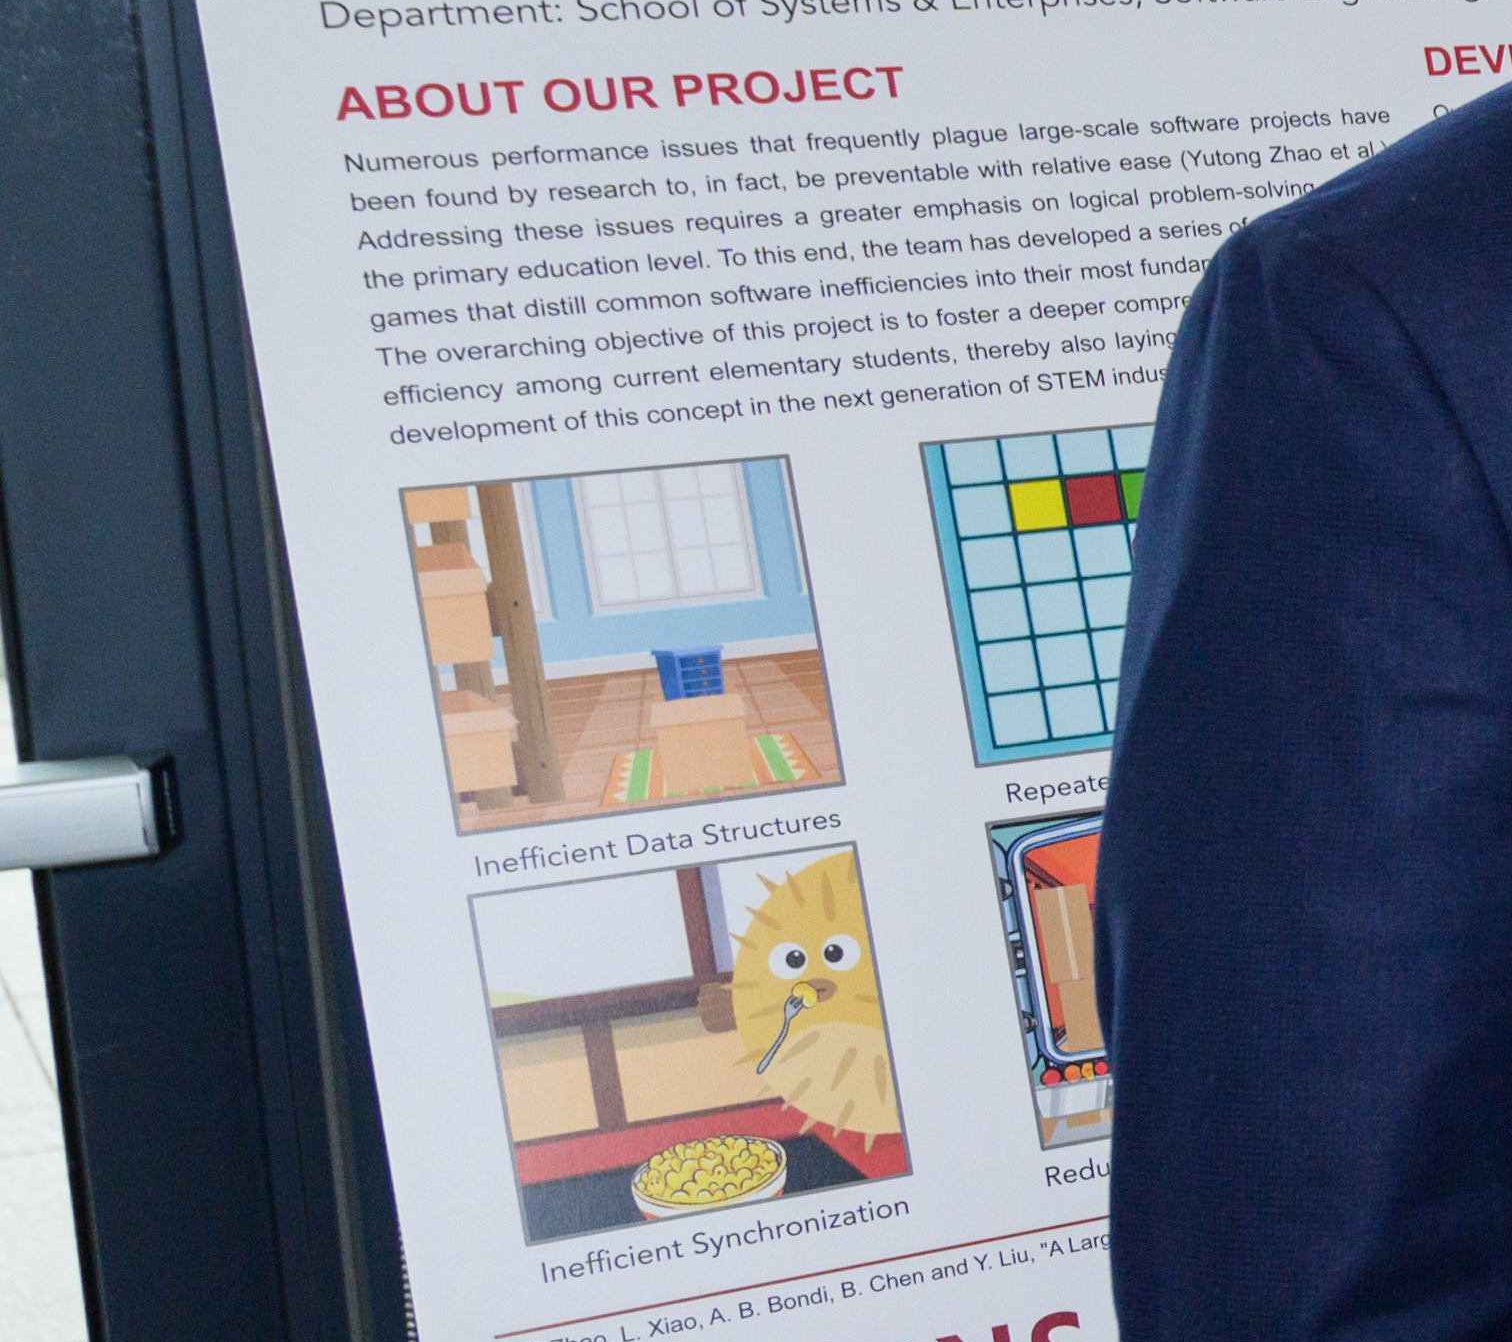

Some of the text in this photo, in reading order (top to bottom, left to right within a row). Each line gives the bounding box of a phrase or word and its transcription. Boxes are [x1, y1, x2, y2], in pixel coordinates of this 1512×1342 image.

[319, 0, 563, 37] Department:
[336, 66, 904, 121] ABOUT OUR PROJECT
[343, 108, 1390, 173] Numerous performance issues that frequently plague large-scale software projects have
[357, 225, 503, 251] Addressing
[513, 222, 584, 242] these
[595, 218, 675, 237] issues
[685, 210, 784, 235] requires
[794, 211, 809, 226] a
[819, 203, 902, 229] greater
[913, 195, 1022, 221] emphasis
[1031, 196, 1060, 212] on
[1069, 188, 1139, 213] logical
[370, 308, 458, 333] games
[466, 301, 516, 322] that
[524, 295, 587, 318] distill
[595, 292, 702, 314] common
[710, 284, 812, 306] software
[819, 272, 968, 298] inefficiencies
[975, 268, 1017, 287] into
[1023, 264, 1073, 284] their
[1080, 260, 1134, 281] most
[383, 329, 1178, 406] efficiency among current elementary students, thereby also laying
[1006, 775, 1109, 805] Repeate
[474, 813, 842, 877] Inefficient Data Structures
[1045, 1157, 1111, 1187] Redu
[541, 1200, 910, 1284] Inefficient Synchronization
[620, 1326, 641, 1342] L.
[647, 1316, 704, 1338] Xiao,
[709, 1307, 732, 1326] A.
[738, 1301, 761, 1320] B.
[767, 1285, 835, 1314] Bondi,
[840, 1280, 863, 1299] B.
[869, 1271, 925, 1293] Chen
[931, 1258, 969, 1281] and
[973, 1253, 993, 1271] Y.
[998, 1248, 1035, 1267] Liu,
[1040, 1239, 1065, 1258] "A
[1067, 1231, 1113, 1255] Larg
